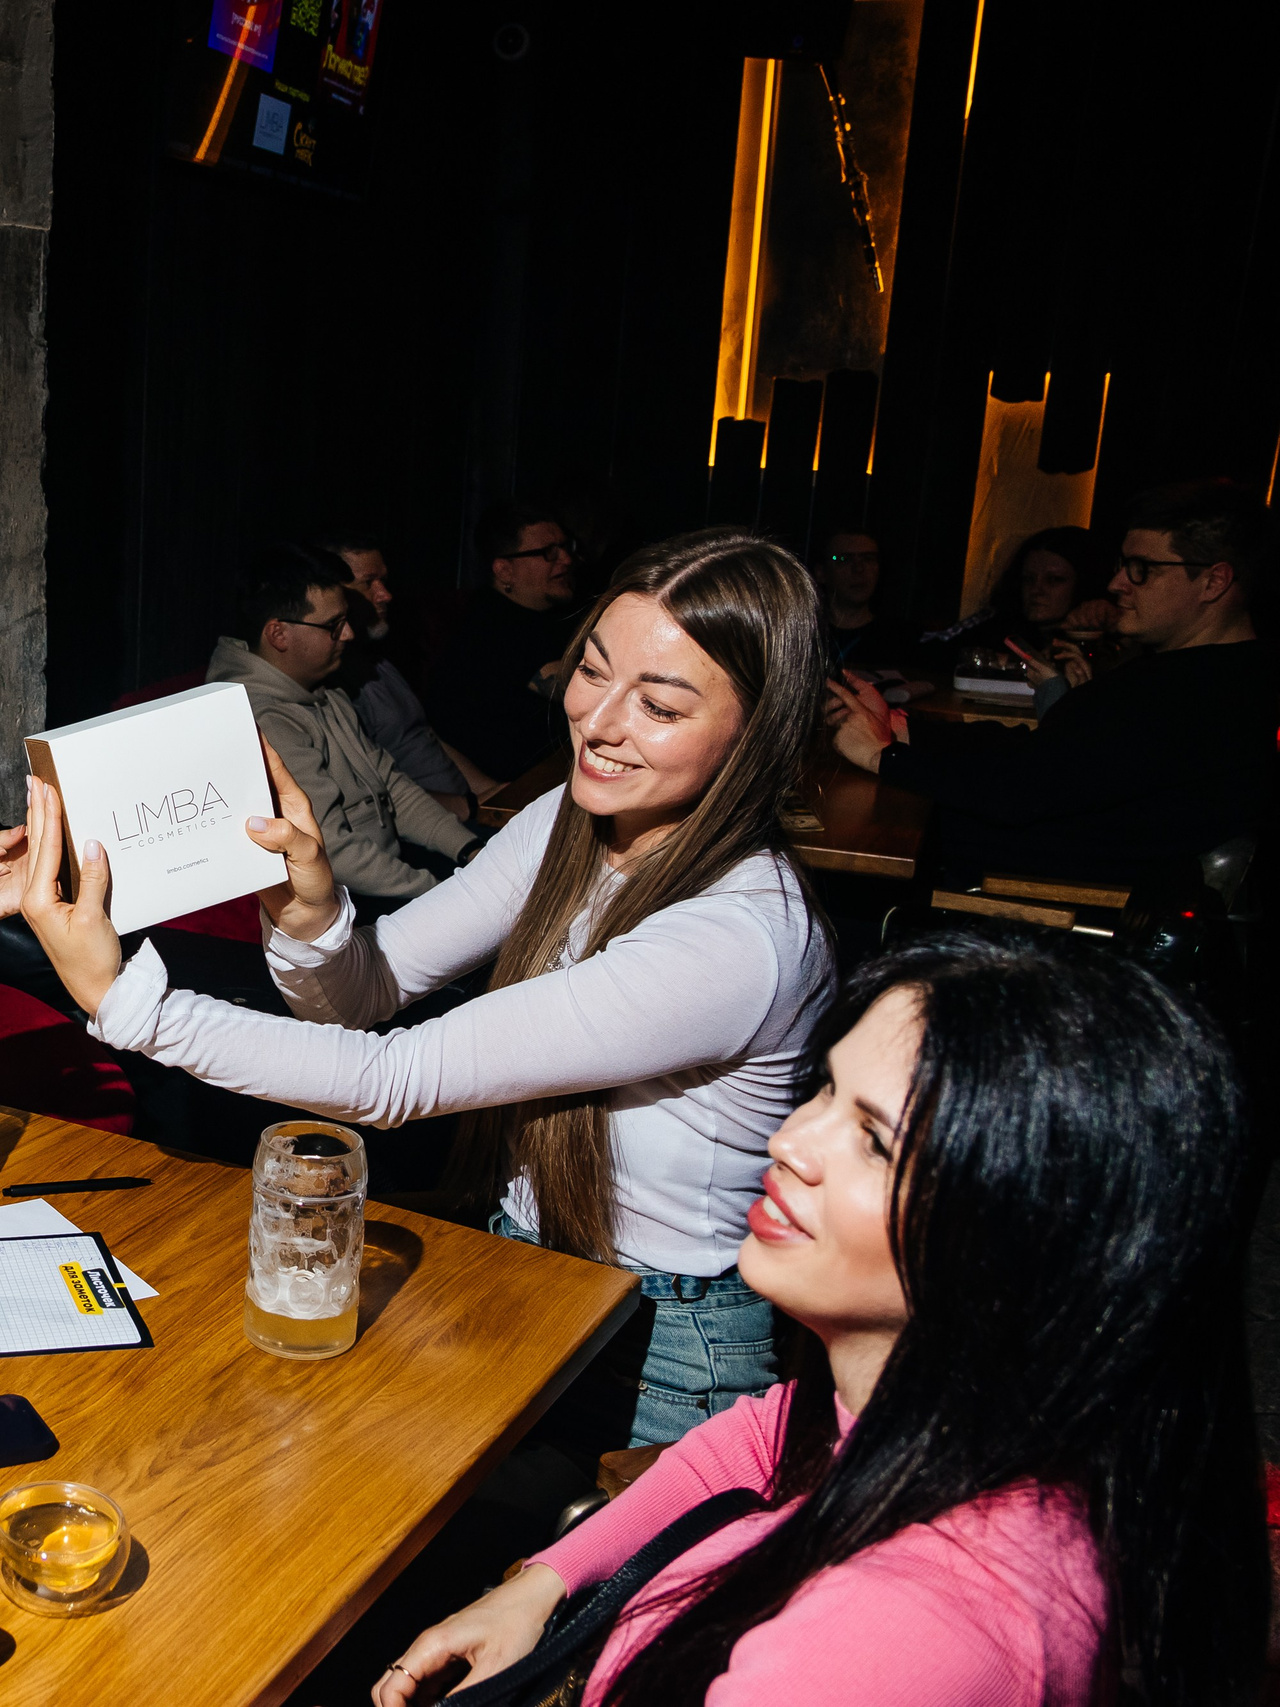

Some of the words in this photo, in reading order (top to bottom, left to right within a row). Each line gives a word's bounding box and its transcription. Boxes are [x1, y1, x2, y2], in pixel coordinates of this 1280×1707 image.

[112, 781, 229, 842] LIMBA
[137, 817, 217, 848] COSMETICS
[166, 857, 209, 875] limba.cosmetics
[62, 1265, 78, 1280] для
[71, 1279, 96, 1313] заметок
[86, 1270, 116, 1308] Листочек
